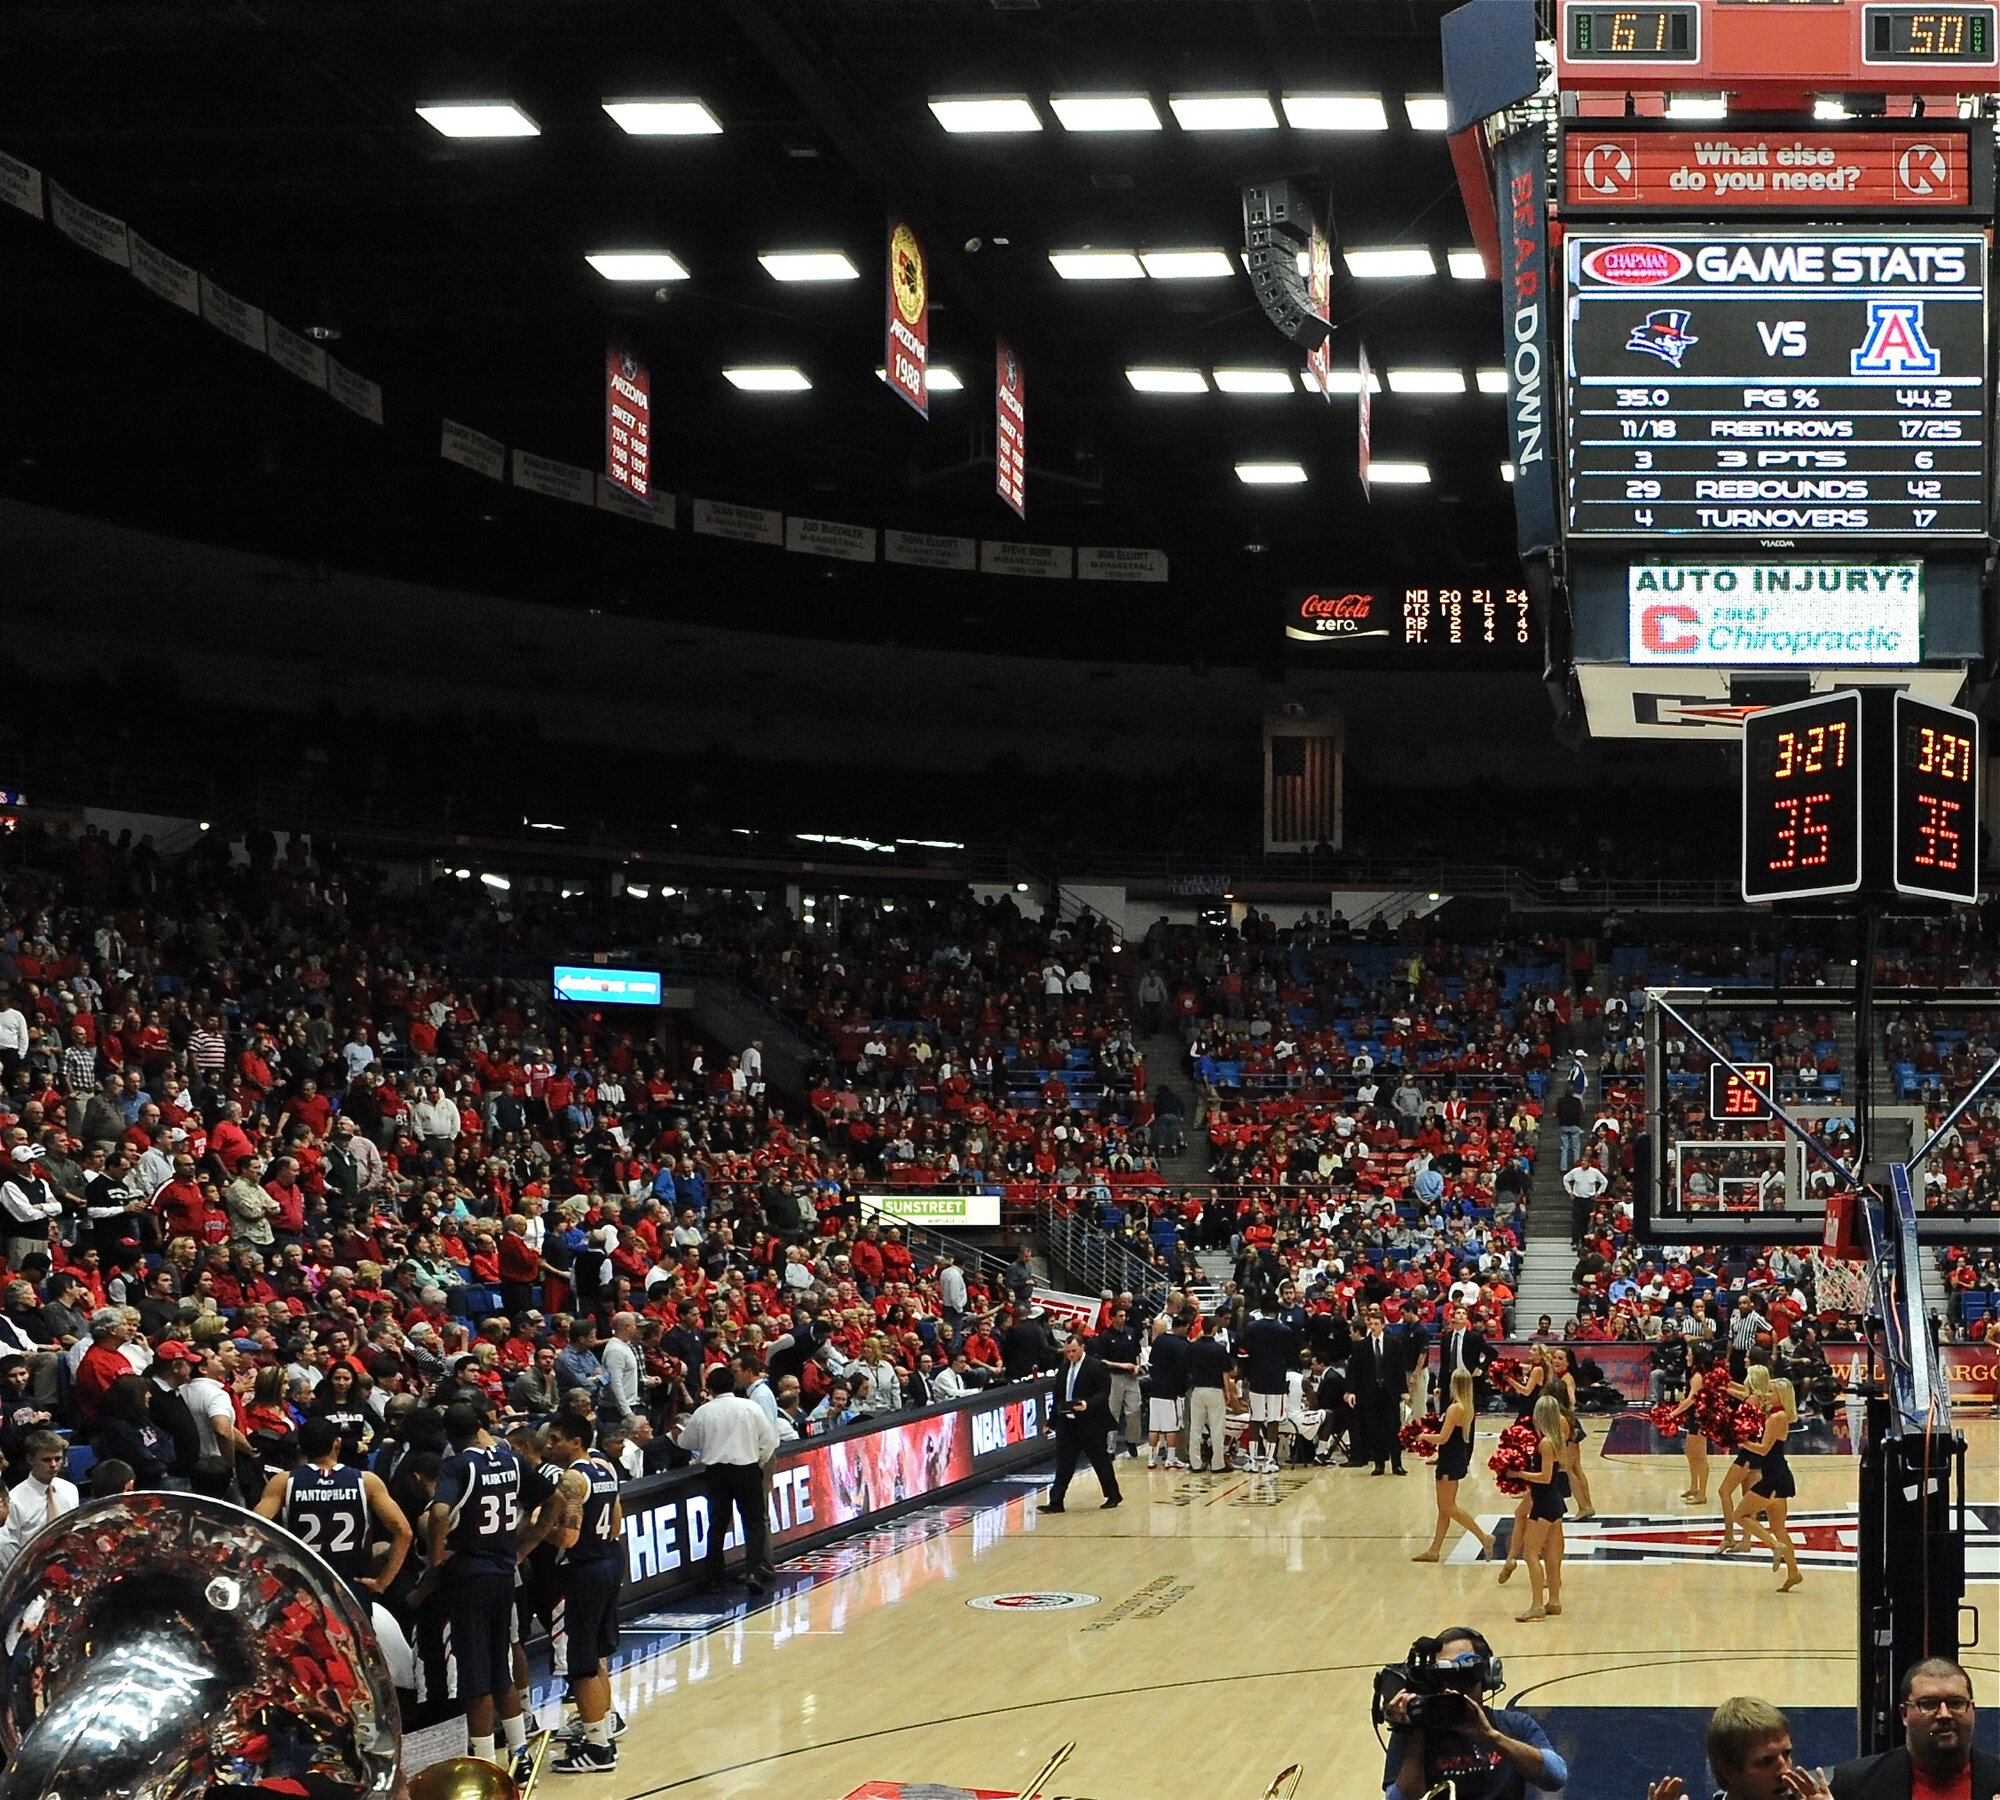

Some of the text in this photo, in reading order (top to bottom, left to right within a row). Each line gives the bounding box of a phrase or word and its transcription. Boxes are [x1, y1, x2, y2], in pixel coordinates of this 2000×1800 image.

[1611, 14, 1665, 51] 61
[1910, 15, 1965, 54] 50
[1694, 142, 1835, 166] What else
[1669, 166, 1861, 196] do you need?
[1604, 253, 1669, 269] CHAPMAN
[1696, 246, 1965, 282] GAME STATS
[1511, 171, 1543, 466] BEAR DOWN
[889, 318, 925, 363] ARIZONA
[1757, 321, 1807, 357] VS
[1851, 300, 1940, 377] A
[894, 353, 920, 395] 1988
[611, 374, 648, 410] ARIZONA
[1616, 389, 1670, 408] 35.0
[1744, 389, 1820, 408] FG %
[1896, 389, 1952, 408] 44.2
[1620, 420, 1676, 438] 11/18
[1710, 421, 1853, 438] FREETHROWS
[1899, 421, 1962, 438] 17/25
[1634, 451, 1653, 469] 3
[1717, 450, 1847, 468] 3 PTS
[1914, 451, 1934, 469] 6
[1626, 480, 1661, 498] 29
[1695, 481, 1868, 498] REBOUNDS
[1907, 480, 1941, 498] 42
[1634, 510, 1653, 527] 4
[1696, 509, 1869, 527] TURNOVERS
[1913, 510, 1937, 527] 17
[1760, 539, 1795, 547] VIACOM
[1636, 569, 1914, 594] AUTO INJURY?
[1301, 594, 1374, 619] Coca-Cola
[1406, 590, 1529, 603] NO 20 21 24
[1403, 603, 1430, 616] PTS
[1484, 603, 1495, 616] 5
[1517, 603, 1529, 616] 7
[1406, 617, 1528, 630] RB 2 4 4
[1450, 630, 1462, 643] 2
[1484, 630, 1495, 643] 4
[1517, 630, 1528, 643] 0
[1707, 626, 1902, 655] Chiropractic
[1775, 722, 1846, 778] 3:27
[1918, 728, 1971, 782] 3:27
[1770, 793, 1831, 870] 35
[1915, 794, 1961, 870] 35
[1725, 1089, 1757, 1112] 35
[884, 1201, 962, 1213] SUNSTREET
[972, 1409, 1001, 1457] NBA
[481, 1469, 517, 1485] MARTIN
[295, 1488, 358, 1502] PANTOPHLET
[479, 1491, 517, 1535] 35
[596, 1502, 610, 1540] 4
[298, 1512, 355, 1552] 22
[619, 1503, 681, 1583] HE
